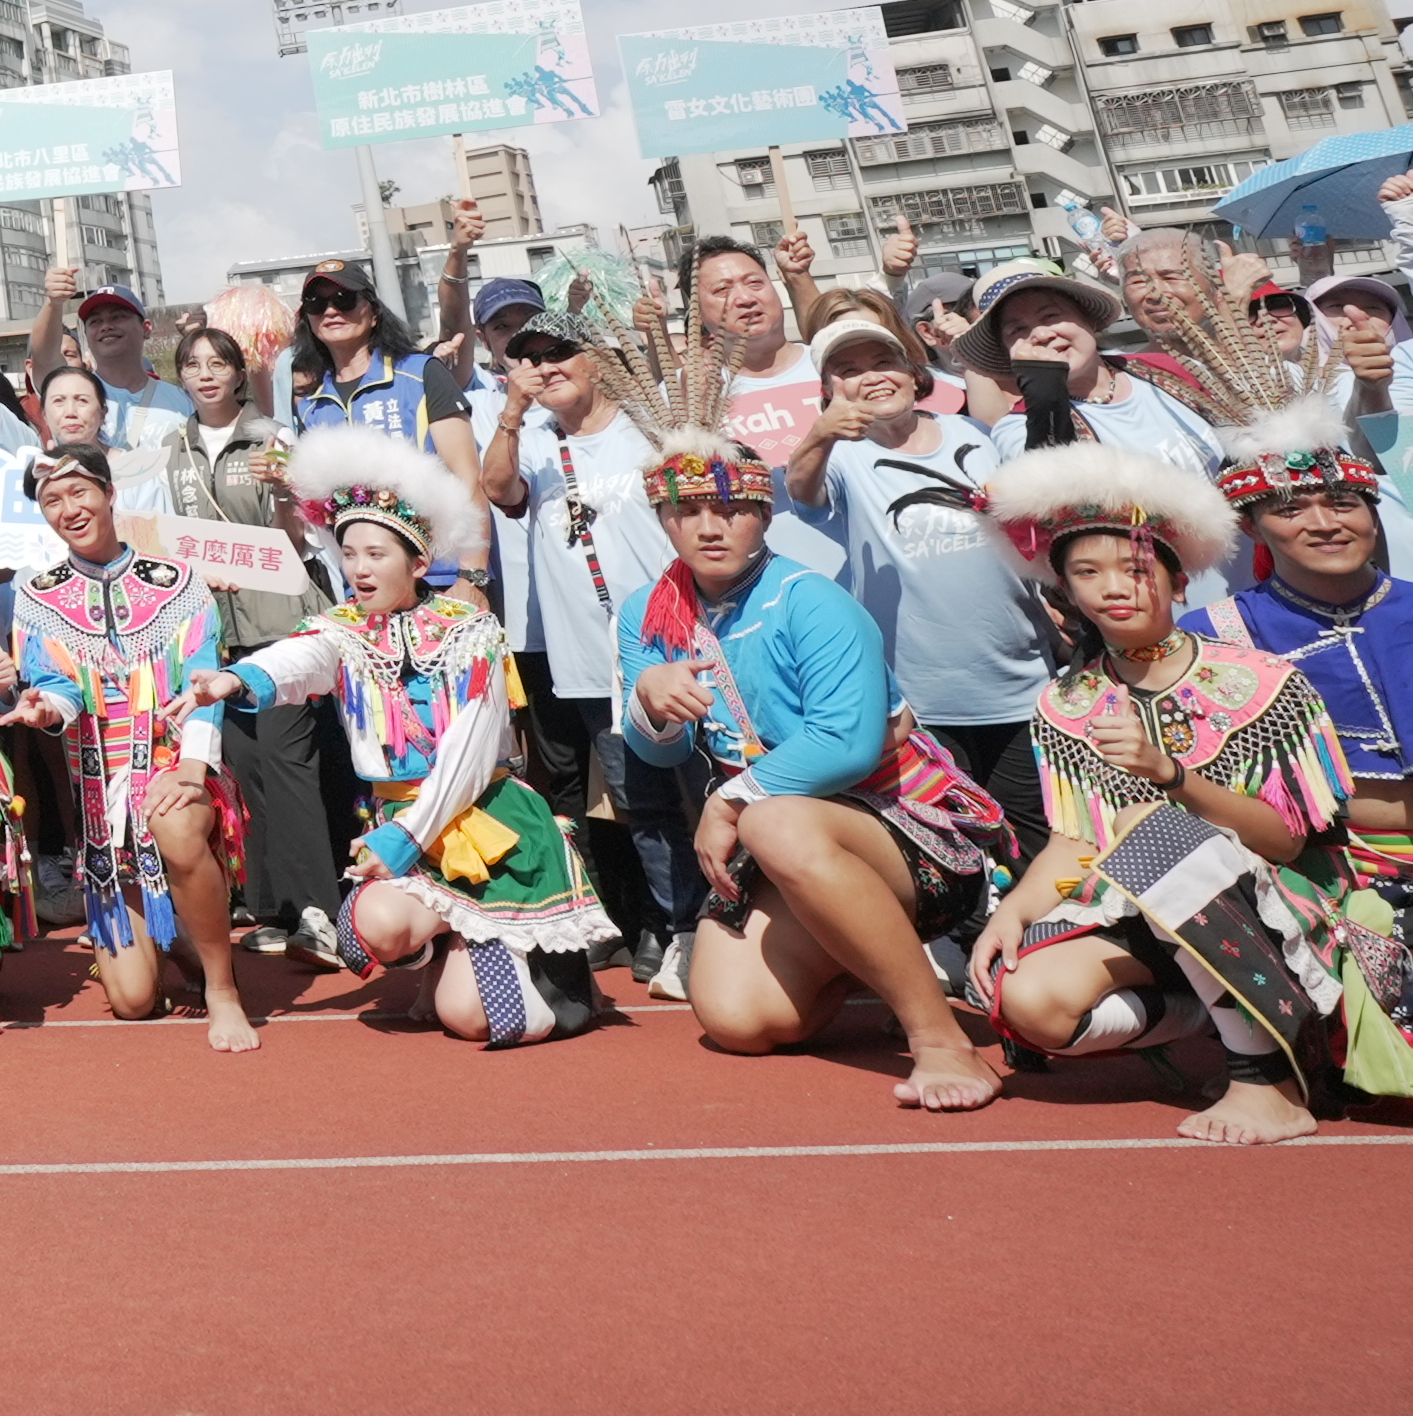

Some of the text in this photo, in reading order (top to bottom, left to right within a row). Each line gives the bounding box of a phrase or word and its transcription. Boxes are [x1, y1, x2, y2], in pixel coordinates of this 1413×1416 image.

[357, 74, 491, 110] 新北市樹林區
[664, 85, 818, 121] 雷女文化藝術團
[330, 95, 529, 138] 原住民族發展協進會
[175, 534, 284, 573] 拿麼厲害
[903, 531, 987, 559] SA'ICELE
